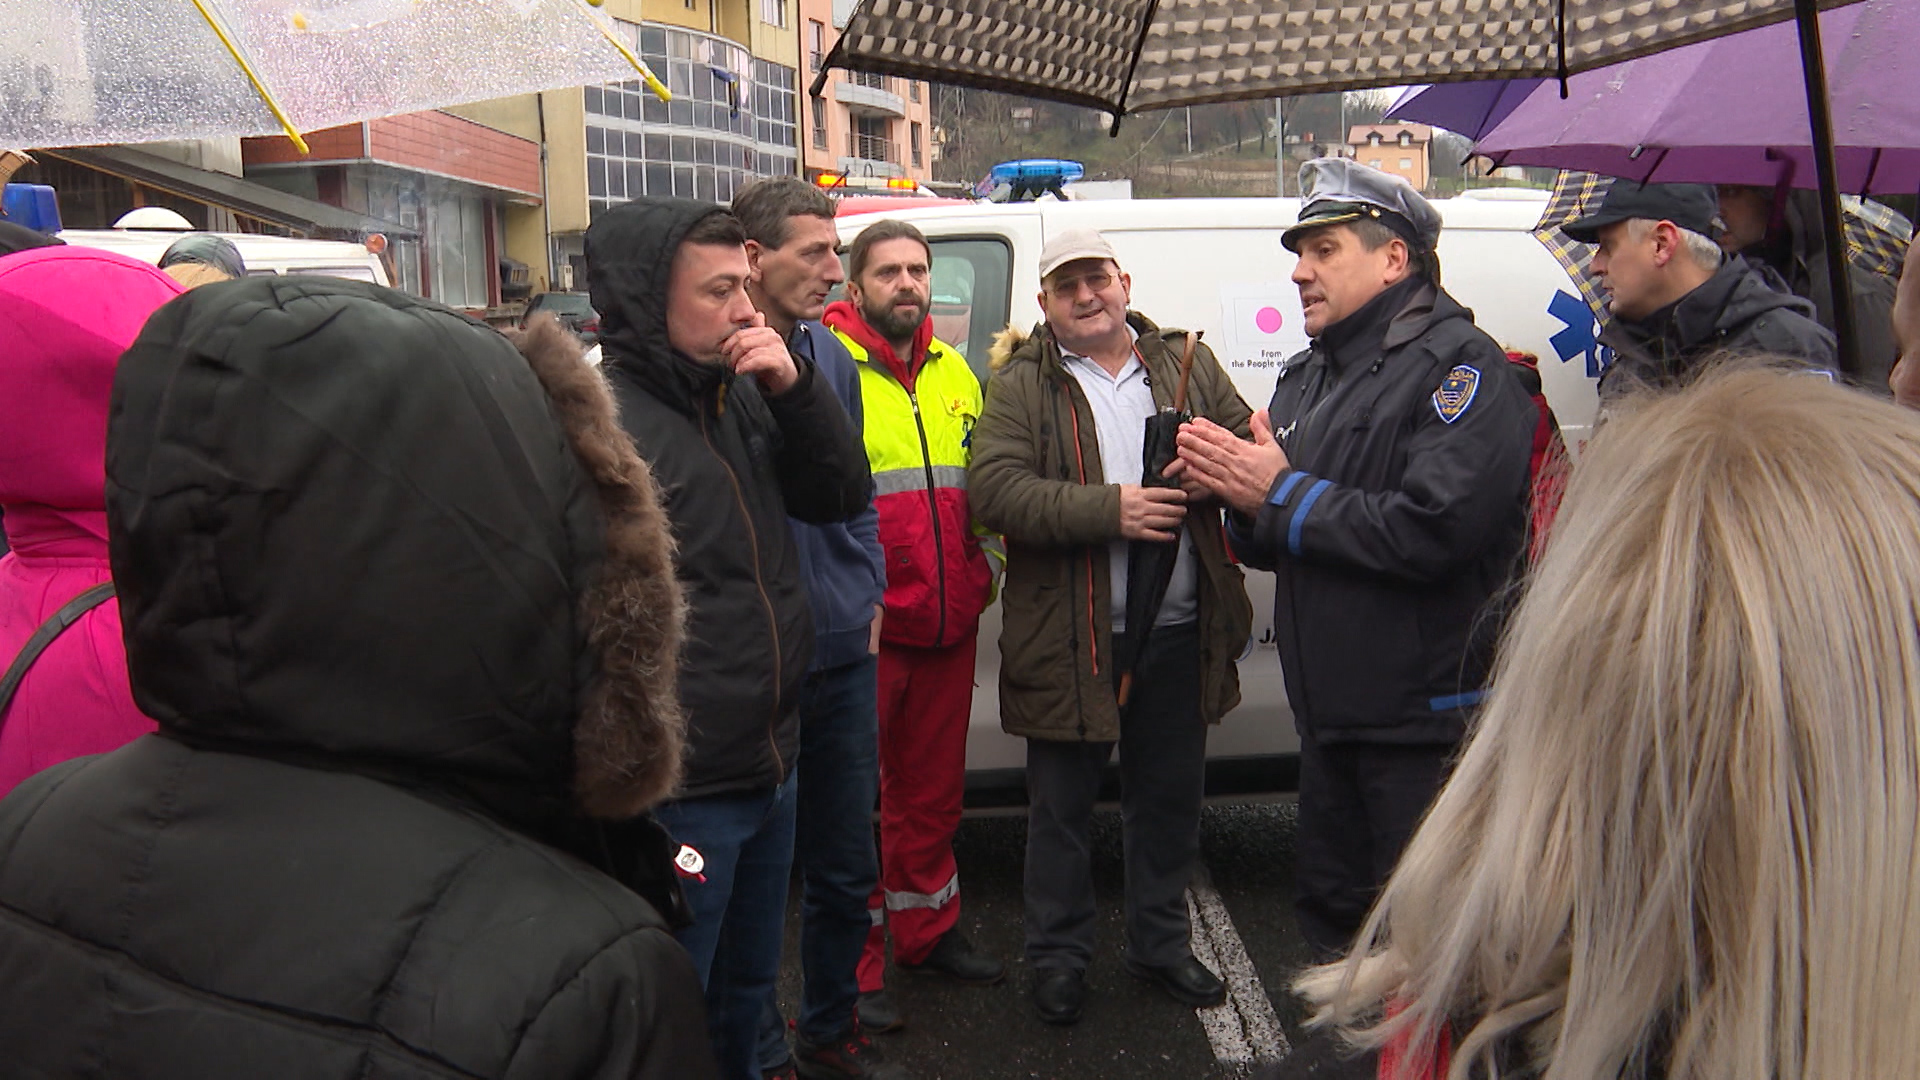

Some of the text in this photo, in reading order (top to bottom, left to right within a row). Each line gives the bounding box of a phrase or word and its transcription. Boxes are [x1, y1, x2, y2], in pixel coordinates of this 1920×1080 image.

[1261, 349, 1282, 358] From
[1232, 359, 1245, 368] the
[1247, 359, 1275, 369] People
